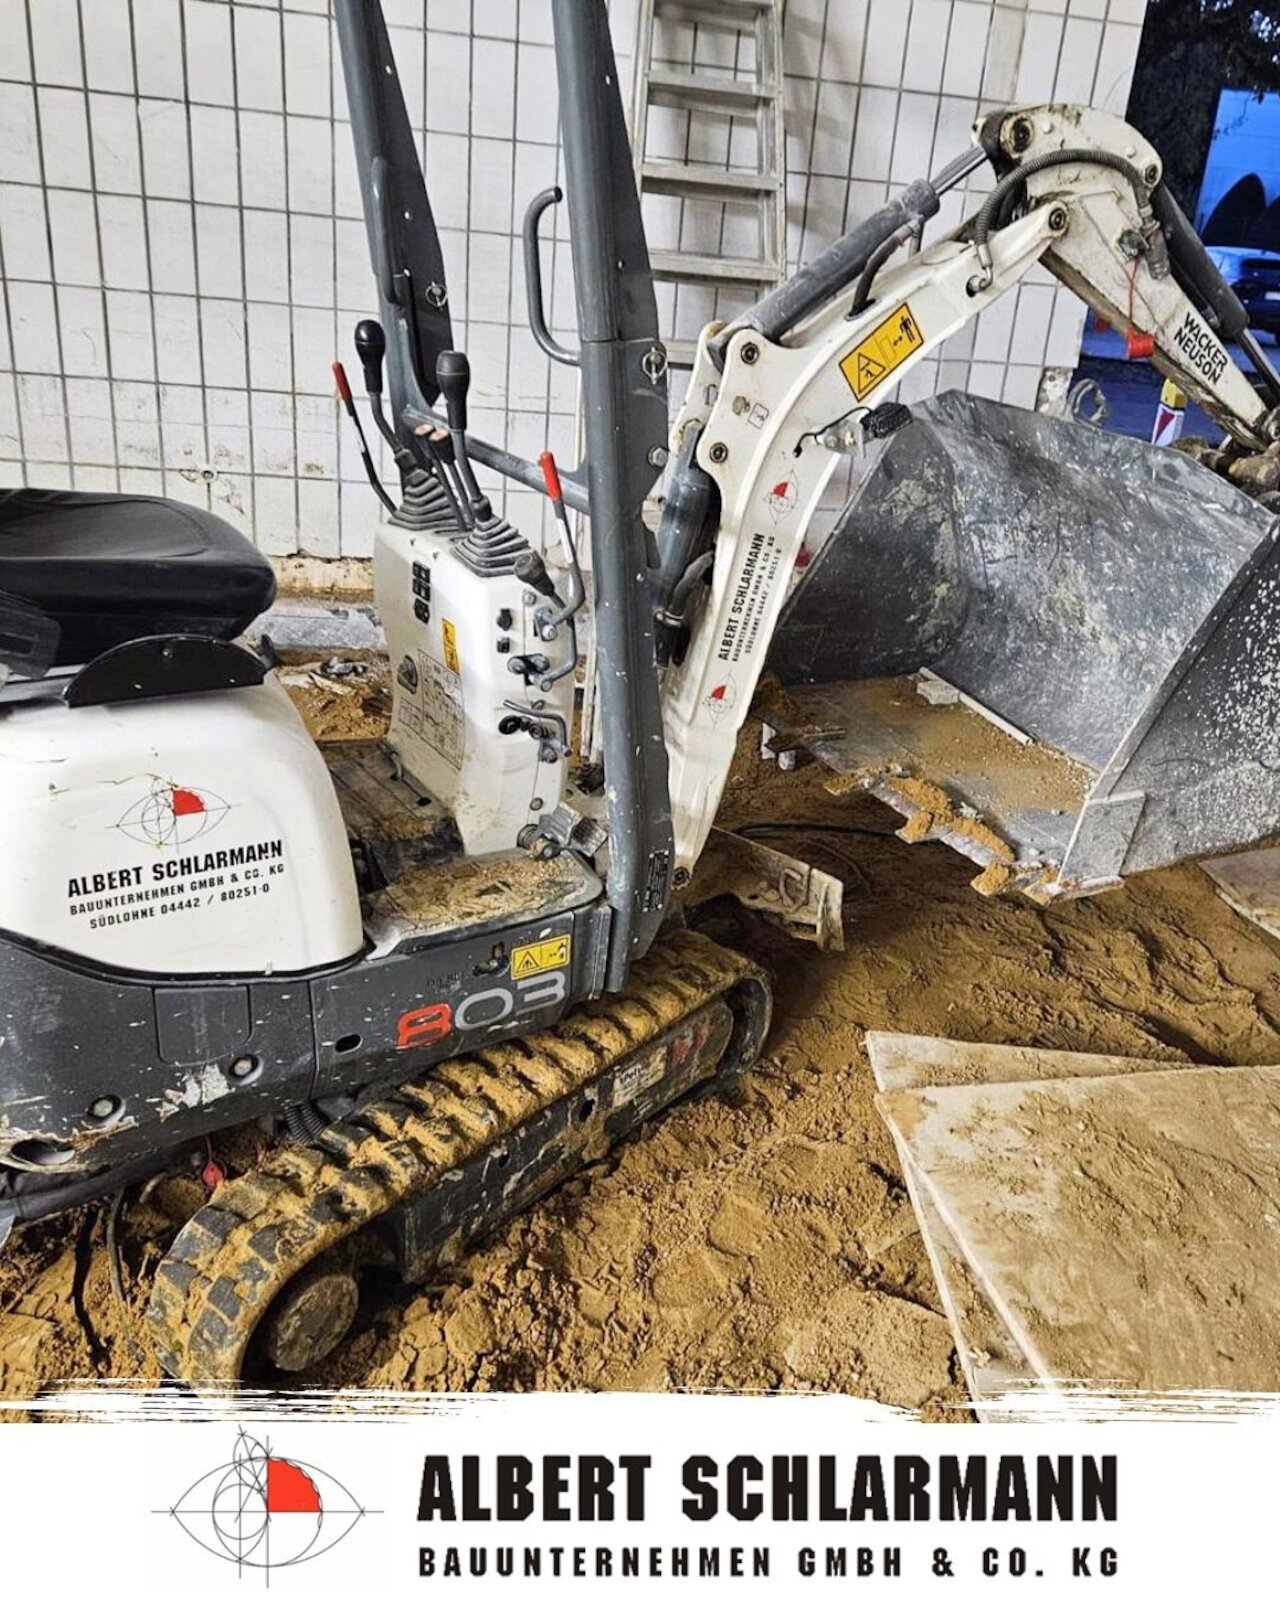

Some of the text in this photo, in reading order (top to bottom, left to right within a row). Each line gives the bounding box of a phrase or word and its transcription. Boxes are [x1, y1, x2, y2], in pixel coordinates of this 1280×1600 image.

[1173, 327, 1221, 384] NEUSON
[1183, 312, 1228, 373] WACKER
[718, 532, 765, 661] ALBERT SCHLARMANN
[68, 839, 283, 898] ALBERT SCHLARMANN
[70, 863, 285, 915] BAUUNTERNEHMEN GMBH & CO. KG
[90, 883, 270, 929] SÜDLOHNE 04442 / 80251-0
[395, 971, 566, 1049] 803
